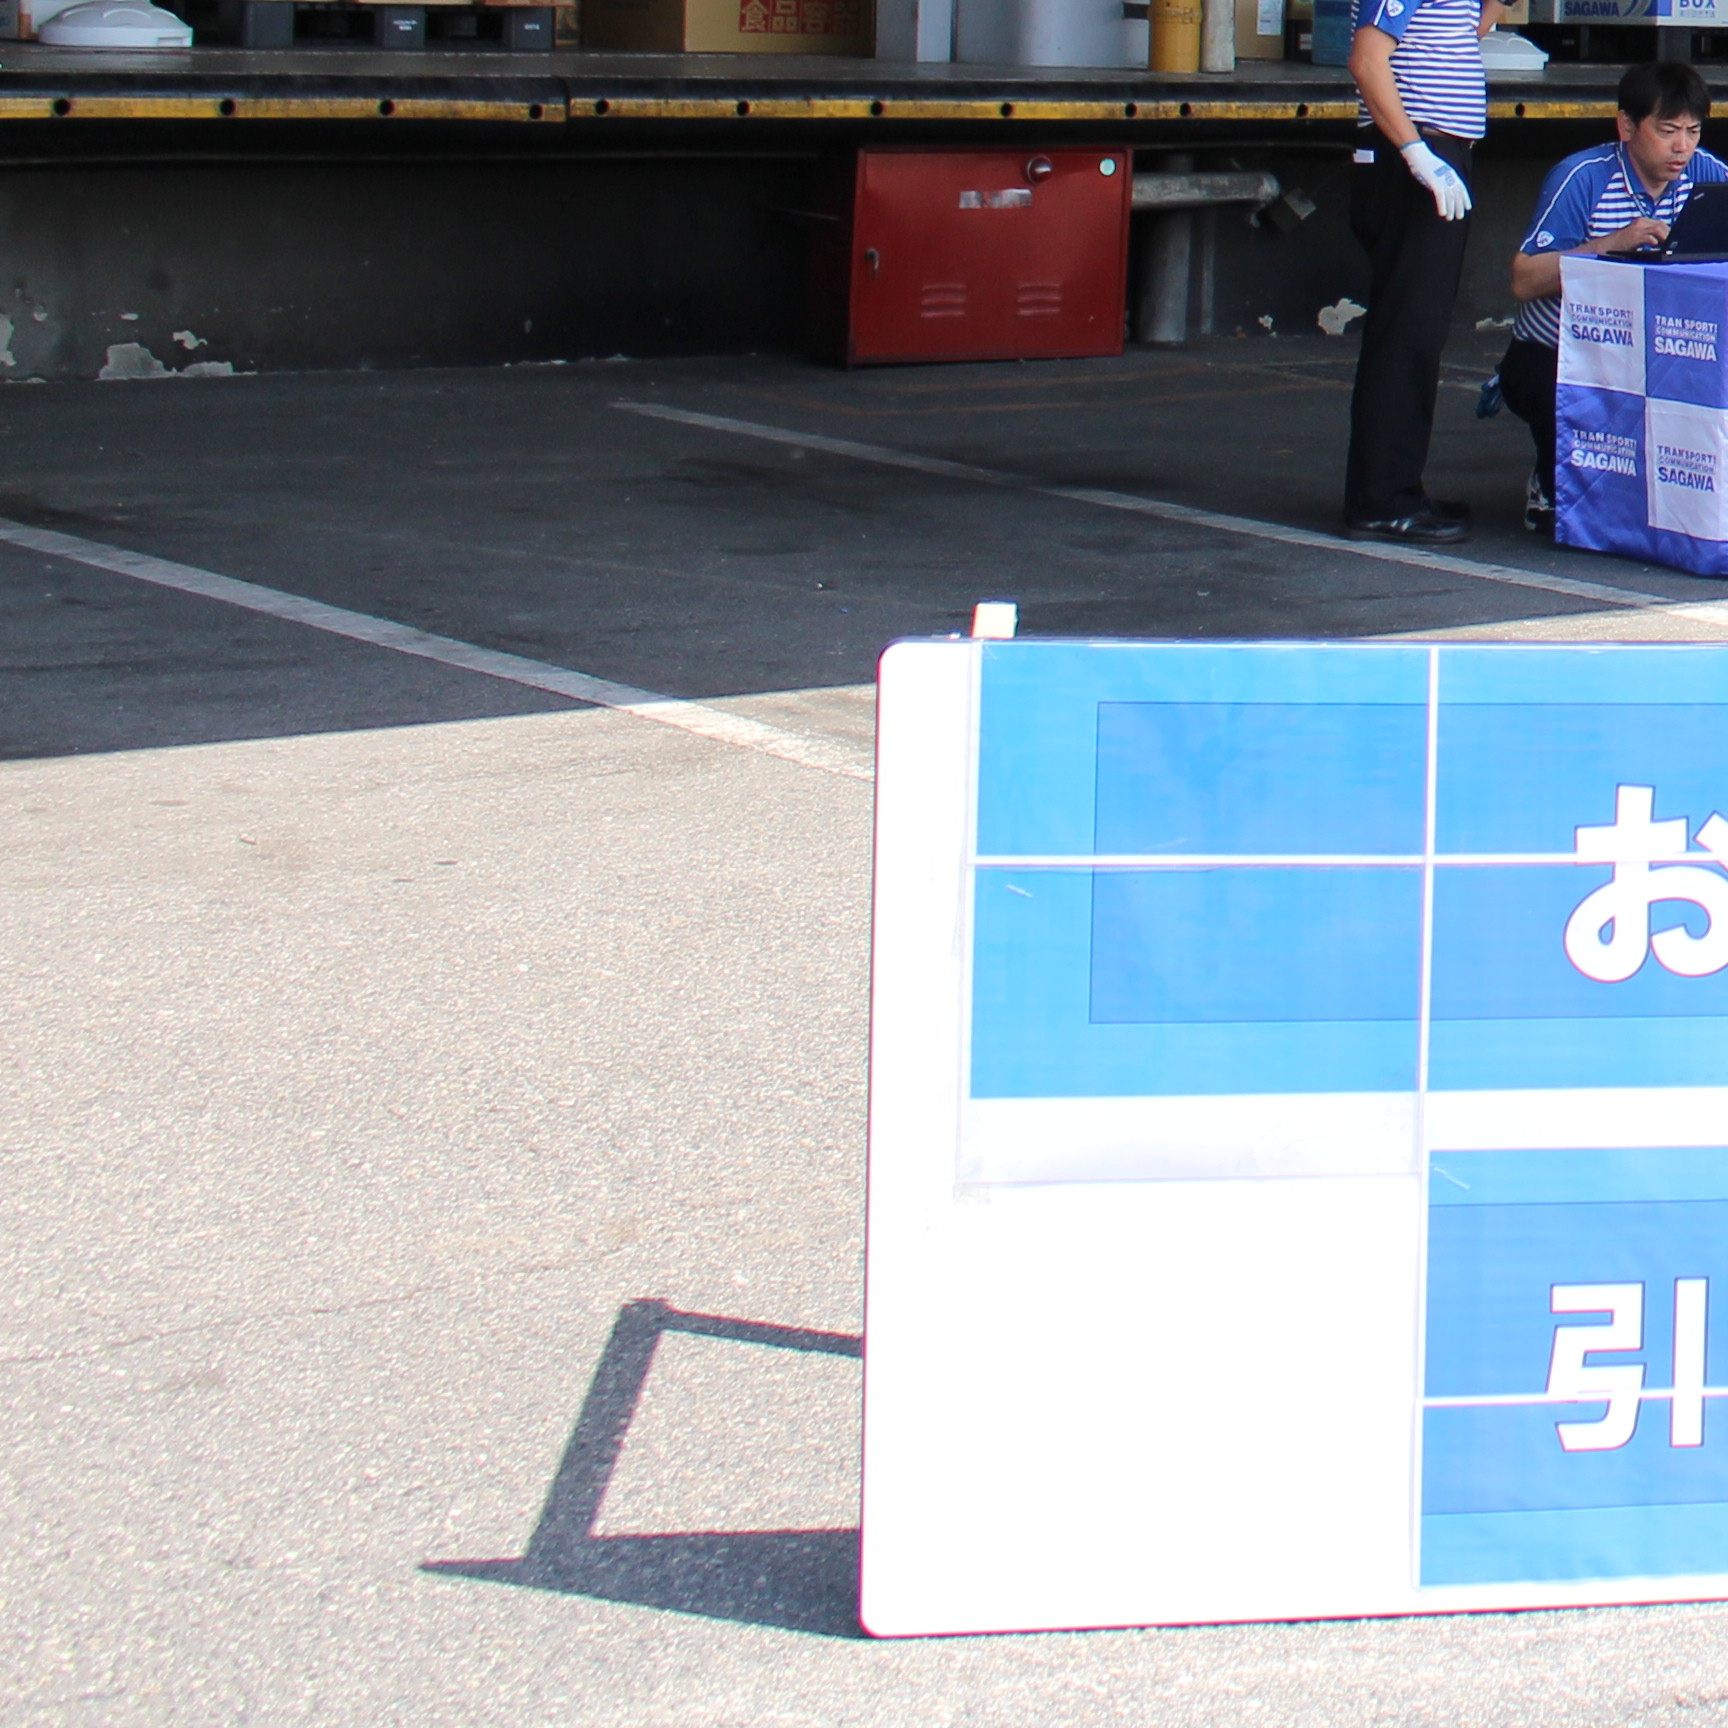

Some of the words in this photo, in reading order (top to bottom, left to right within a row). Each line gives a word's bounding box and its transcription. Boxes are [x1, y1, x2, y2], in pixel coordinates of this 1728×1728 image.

[1565, 1, 1620, 17] SAGAWA
[1571, 324, 1634, 347] SAGAWA
[1654, 337, 1717, 362] SAGAWA
[1571, 449, 1637, 477] SAGAWA
[1658, 467, 1715, 492] SAGAWA
